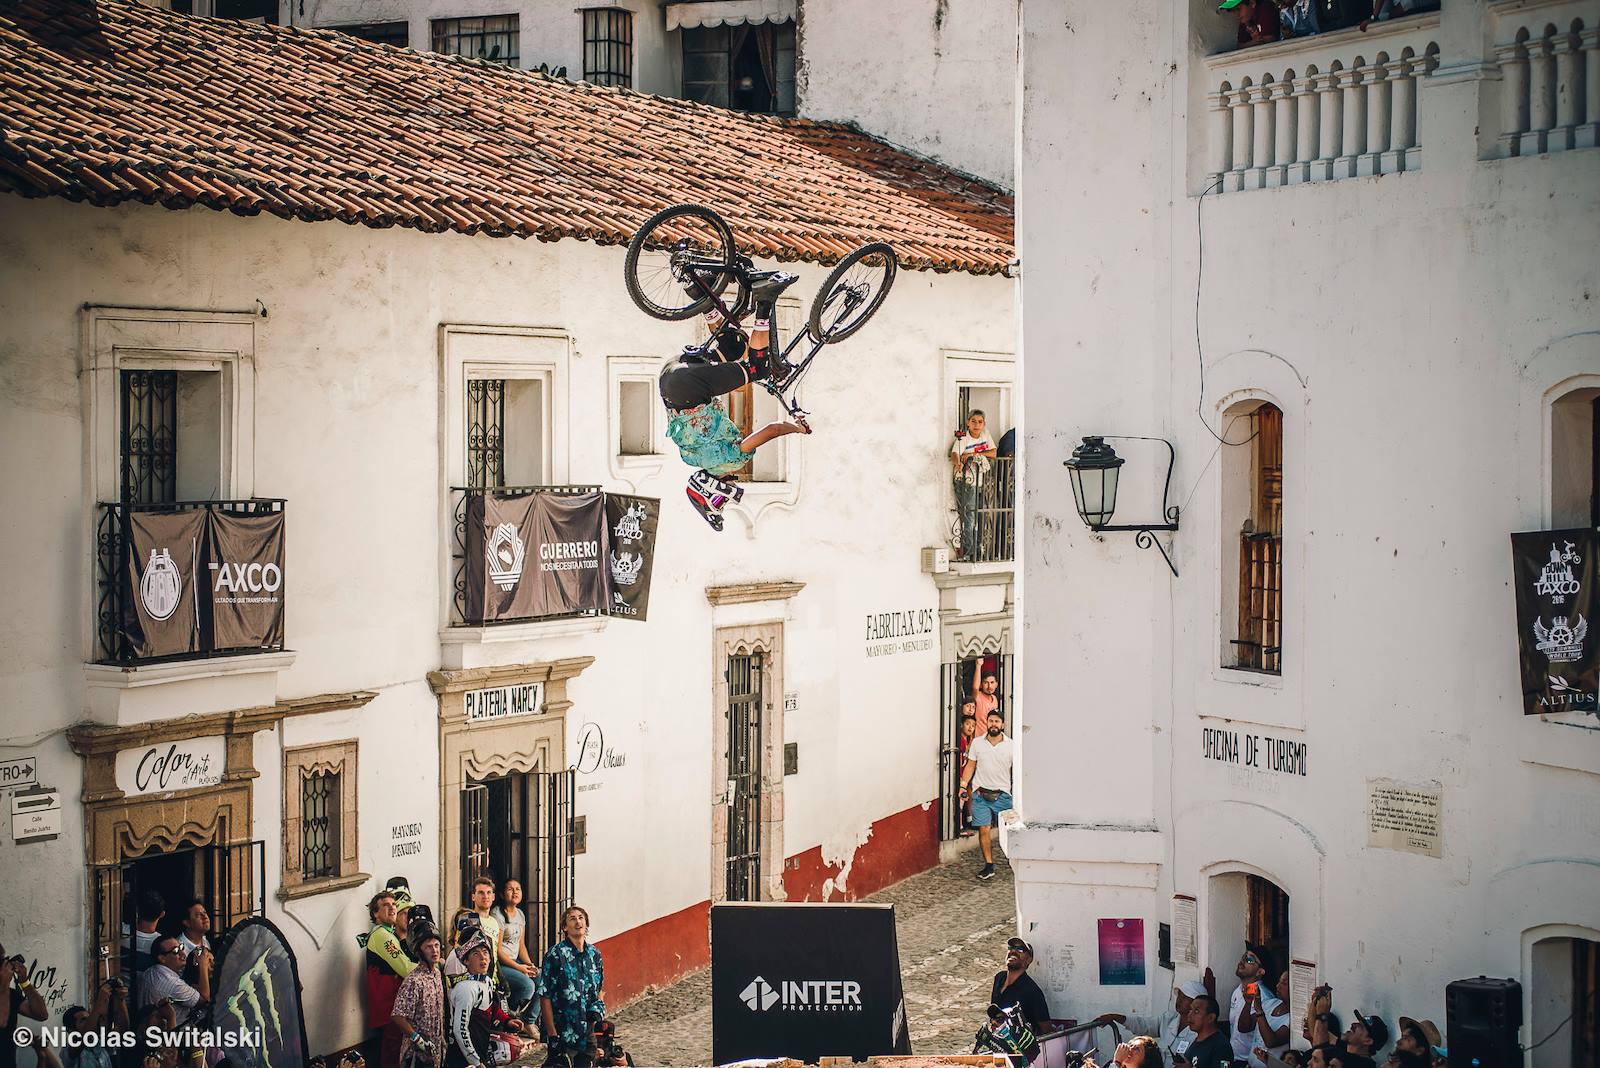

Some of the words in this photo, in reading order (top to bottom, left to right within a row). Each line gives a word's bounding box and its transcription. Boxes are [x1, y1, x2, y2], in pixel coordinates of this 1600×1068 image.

[613, 527, 643, 540] TAXCO
[540, 541, 598, 560] GUERRERO
[541, 562, 552, 571] NOS
[1546, 561, 1568, 574] DOWN
[1546, 573, 1567, 582] HILL
[1533, 580, 1581, 596] TAXCO
[866, 611, 915, 640] FABRITAX
[466, 685, 508, 719] PLATERIA
[511, 684, 538, 714] NARCY
[1540, 693, 1595, 706] ALTIUS
[1203, 728, 1239, 764] OFICINA
[1245, 734, 1259, 767] DE
[1264, 737, 1307, 776] TURISMO
[0, 765, 20, 781] RO
[135, 744, 194, 792] Color
[391, 822, 423, 840] MAYOREO
[391, 840, 422, 858] MENUDEO
[781, 980, 862, 1005] INTER
[782, 1004, 862, 1012] PROTECCION
[460, 1009, 471, 1048] SRAM
